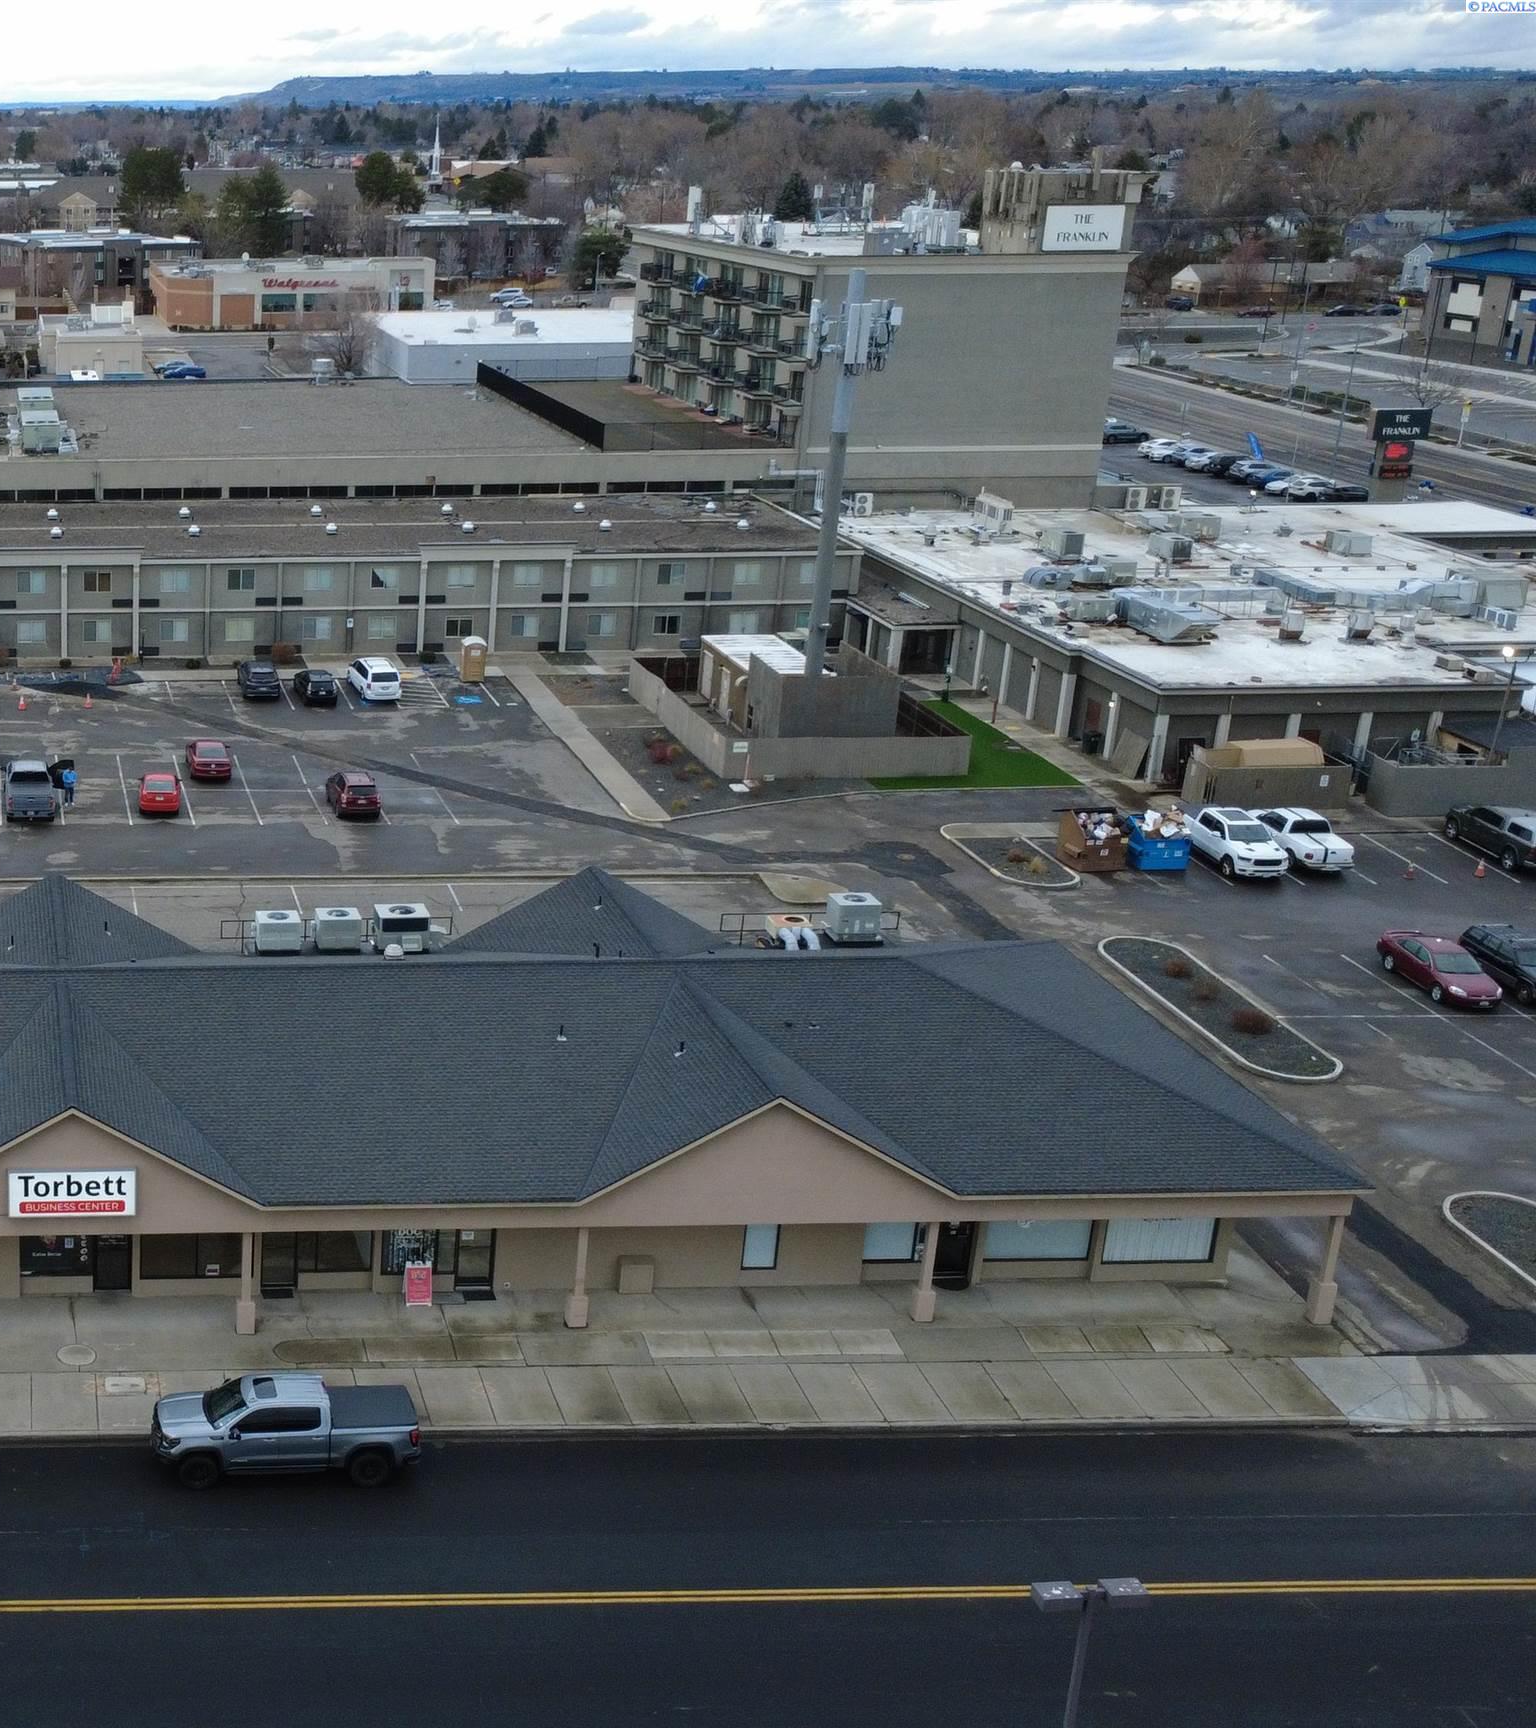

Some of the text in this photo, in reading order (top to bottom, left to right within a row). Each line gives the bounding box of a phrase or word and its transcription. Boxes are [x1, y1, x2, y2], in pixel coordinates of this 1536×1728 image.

[1074, 214, 1095, 224] THE
[1056, 232, 1109, 242] FRANKLIN
[261, 278, 340, 290] Walgreens
[1395, 414, 1411, 423] THE
[1382, 427, 1421, 435] FRANKLIN
[18, 1175, 126, 1197] Torbett
[25, 1202, 119, 1212] BUSINESS CENTER
